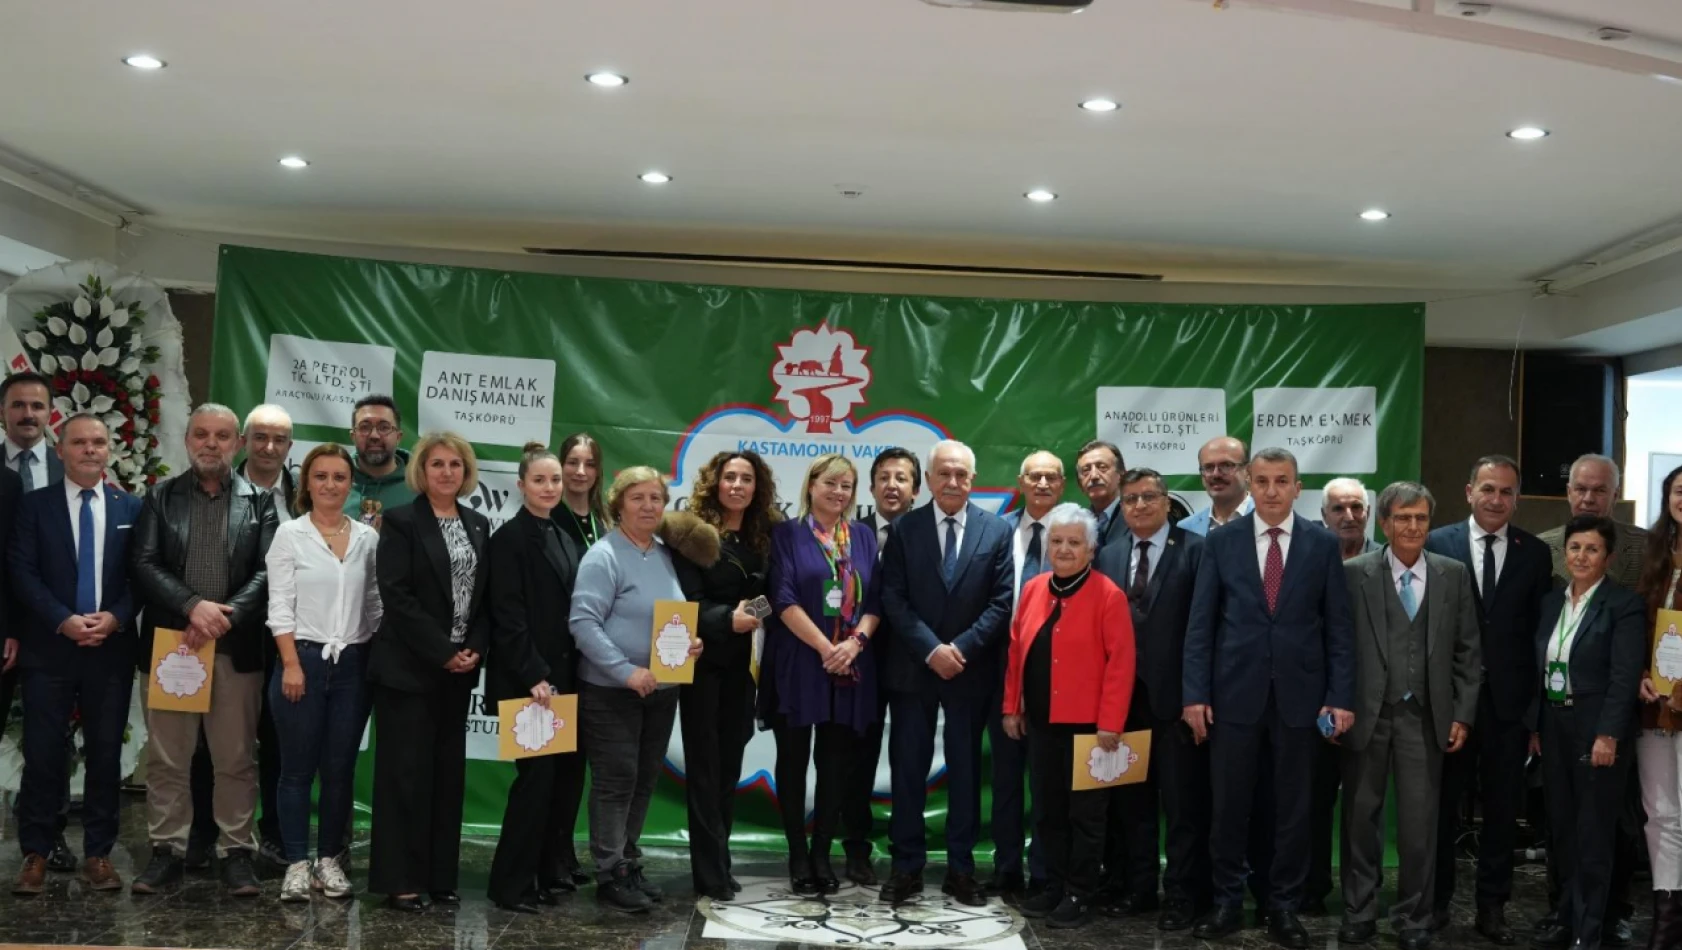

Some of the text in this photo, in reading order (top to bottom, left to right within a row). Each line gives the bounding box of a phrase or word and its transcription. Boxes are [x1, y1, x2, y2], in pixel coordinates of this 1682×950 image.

[292, 359, 367, 379] 2A PETROL
[315, 374, 345, 389] LTD.
[349, 379, 372, 392] ŞTİ
[437, 370, 538, 391] ANT EMLAK
[426, 386, 546, 408] DANIŞMANLIK
[454, 410, 516, 425] TAŞKÖPRÜ
[810, 414, 830, 424] 1997
[1105, 411, 1220, 423] ANADOLU ÜRÜNLERİ
[1256, 413, 1314, 428] ERDEM
[1123, 422, 1200, 438] TİC. LTD. ŞTİ.
[1135, 440, 1187, 451] TAŞKÖPRÜ
[1286, 433, 1343, 447] TAŞKÖPRÜ
[737, 439, 893, 459] KASTAMONU VAK
